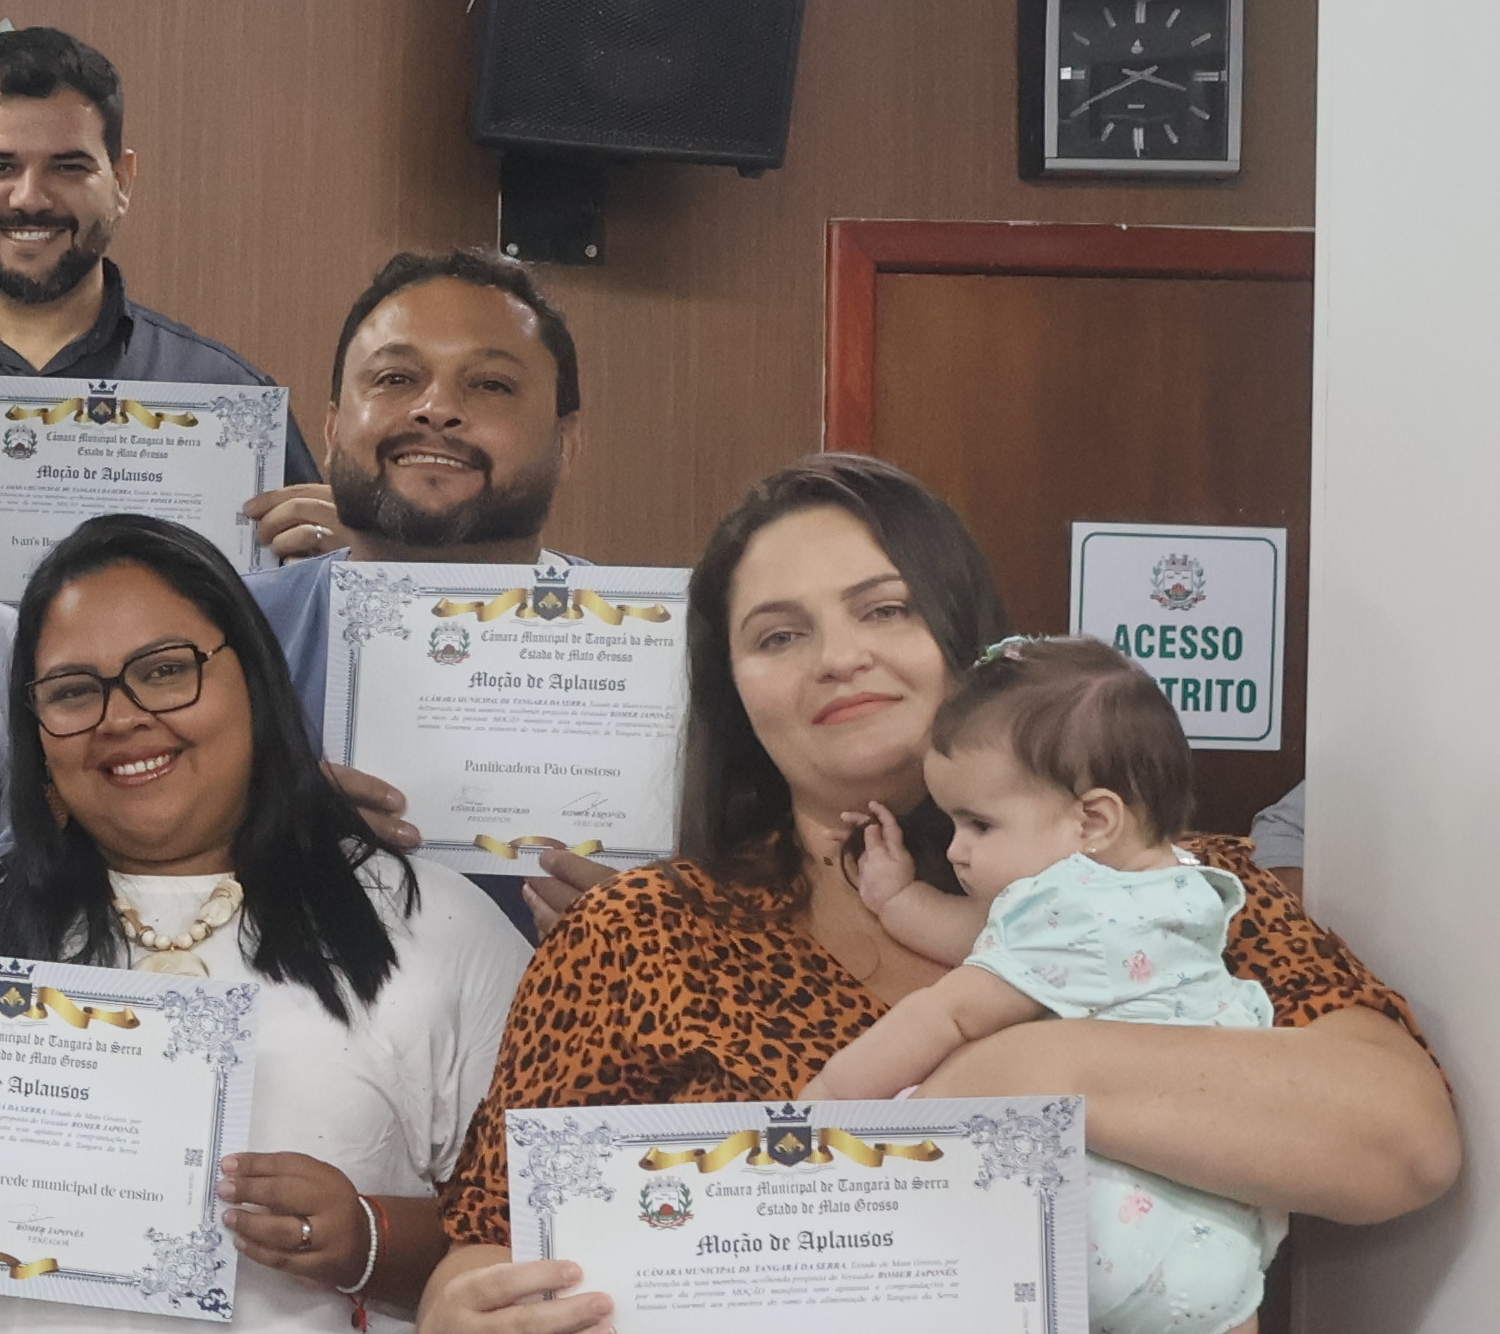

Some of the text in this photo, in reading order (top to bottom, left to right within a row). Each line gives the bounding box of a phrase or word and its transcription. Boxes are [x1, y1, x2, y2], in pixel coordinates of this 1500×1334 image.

[36, 464, 163, 483] Moção de Aplausos
[1113, 624, 1243, 660] ACESSO
[468, 671, 627, 693] Moção de Aplausos
[7, 1075, 90, 1101] Aplausos
[0, 1174, 29, 1188] rede
[31, 1179, 98, 1197] municipal
[100, 1184, 117, 1197] de
[119, 1188, 164, 1202] ensino
[696, 1230, 894, 1258] Moção de Aplausos
